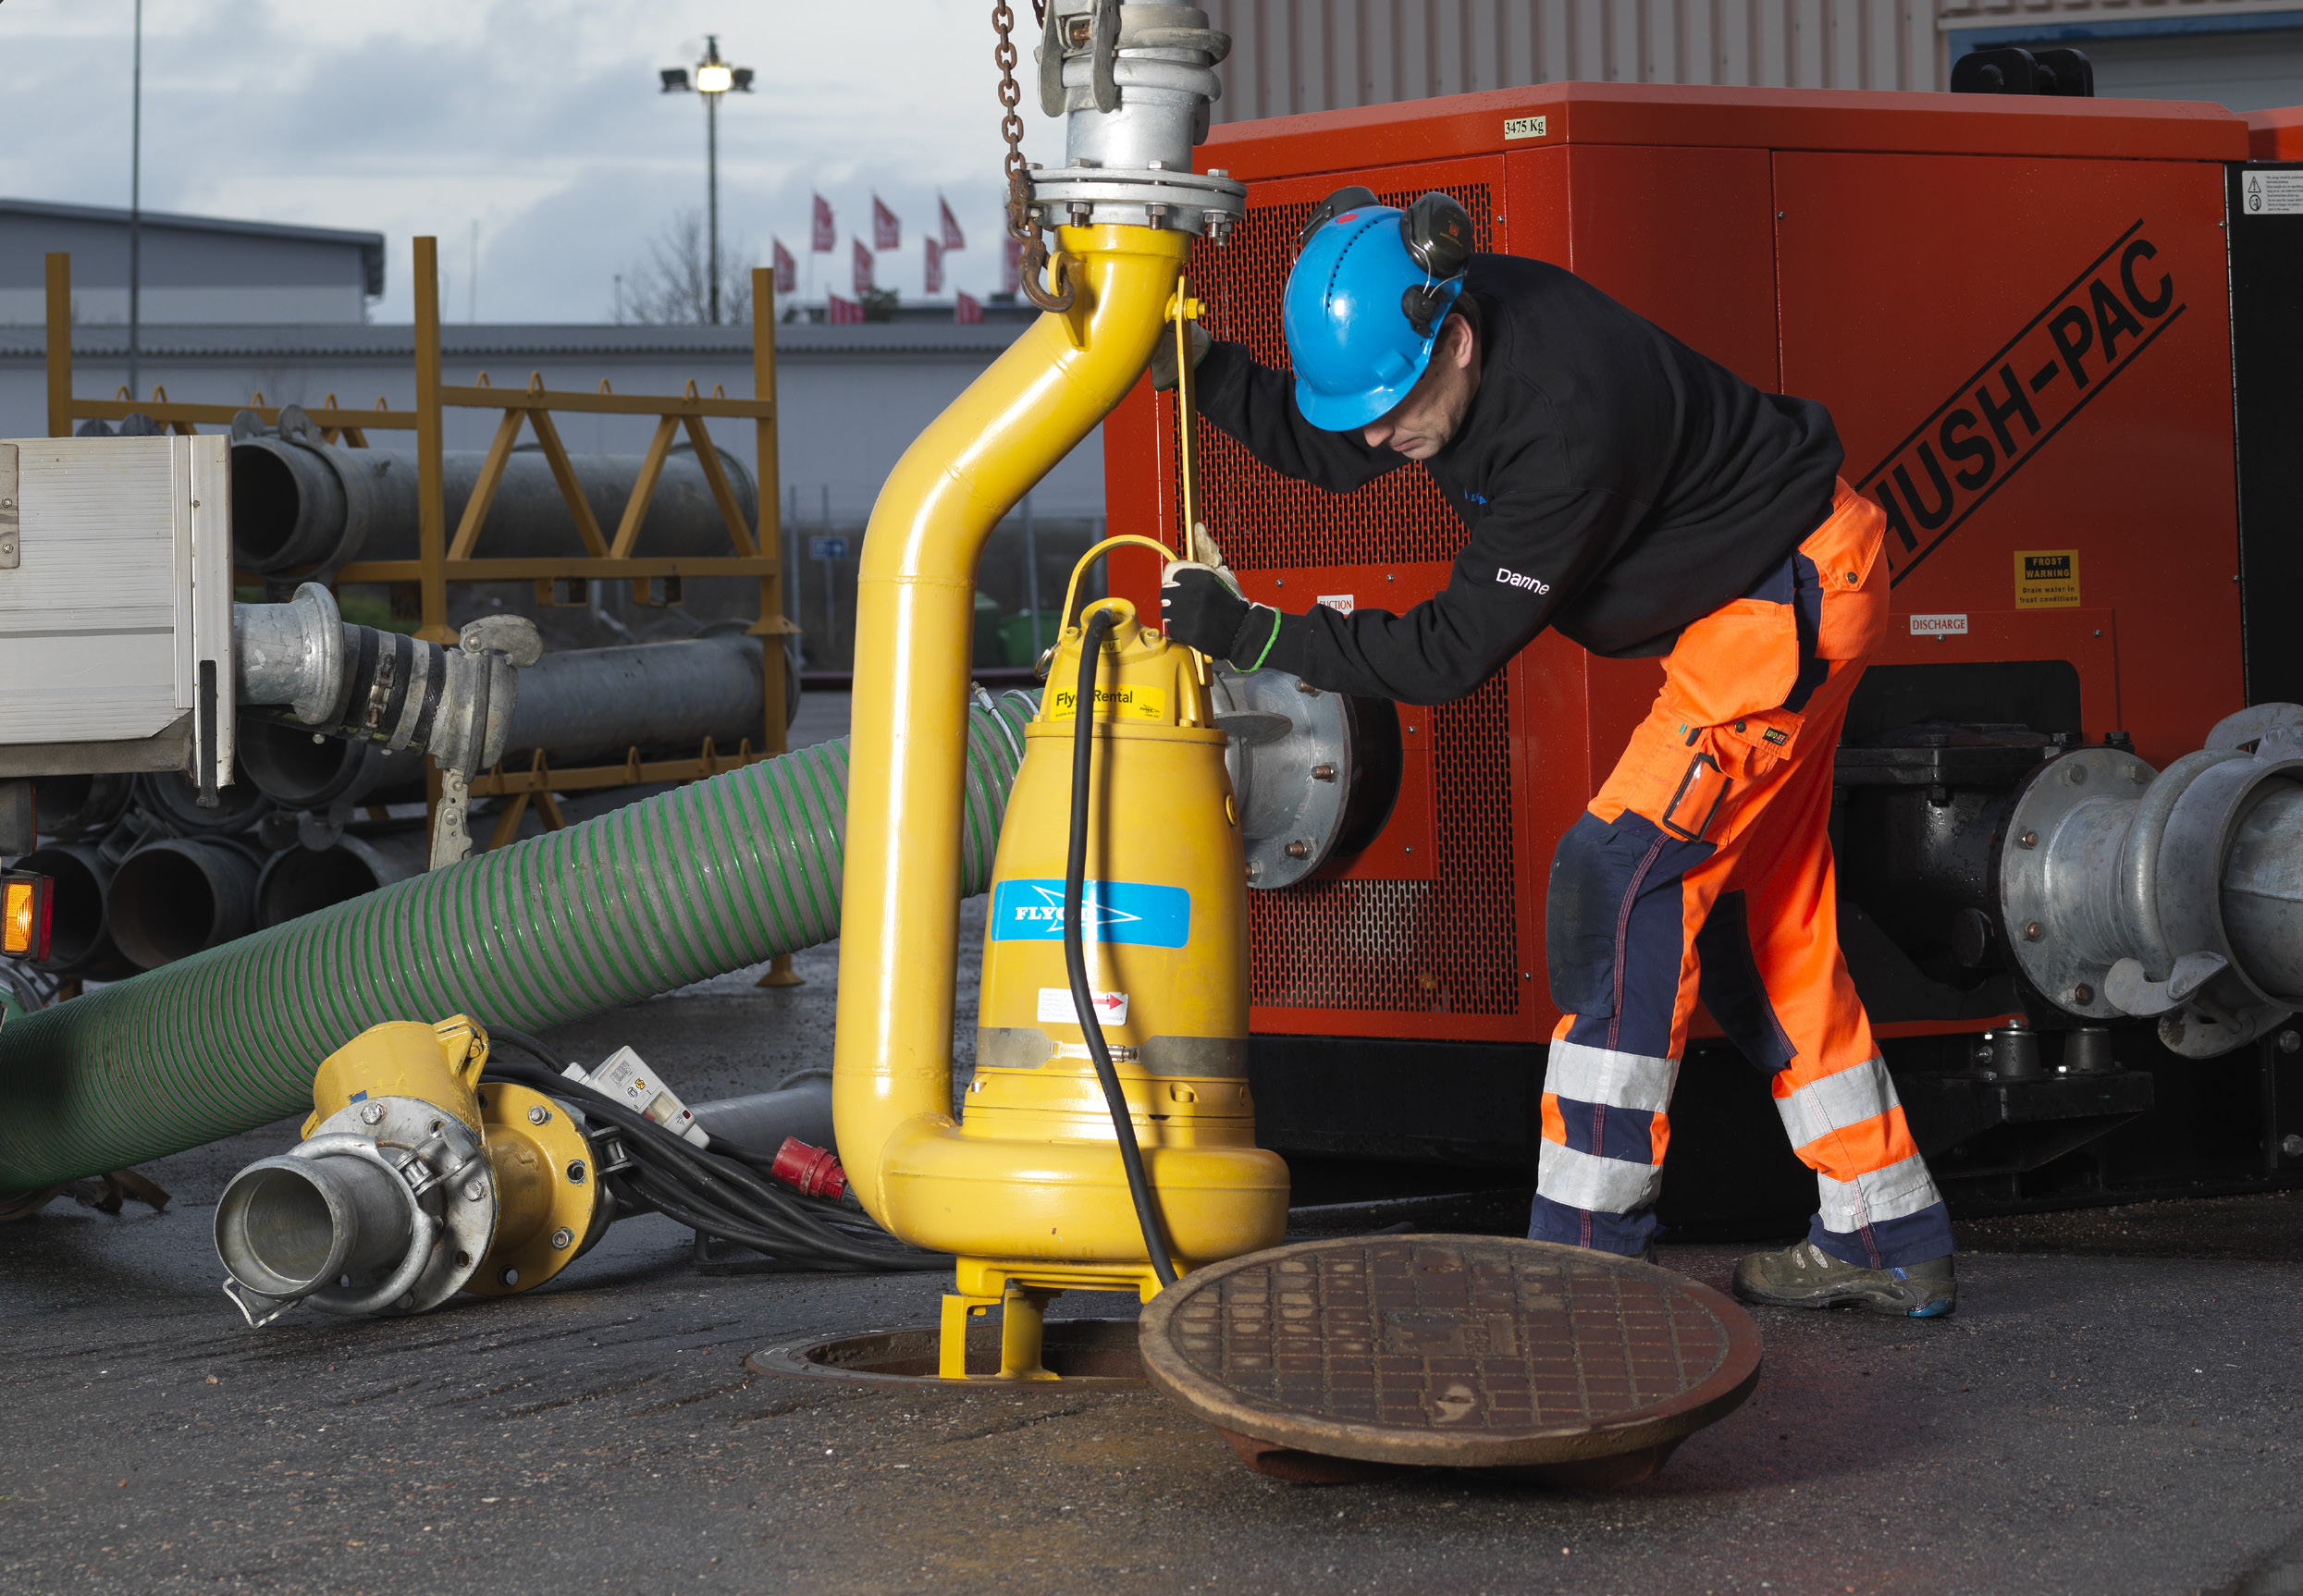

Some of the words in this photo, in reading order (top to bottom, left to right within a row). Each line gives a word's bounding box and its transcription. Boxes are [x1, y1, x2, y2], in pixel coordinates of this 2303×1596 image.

[1505, 120, 1527, 135] 3475
[1530, 118, 1545, 135] Kg
[1874, 239, 2174, 571] HUSH-PAC
[2033, 557, 2063, 566] FROST
[2026, 569, 2070, 579] WARNING
[1496, 567, 1550, 595] Danne
[2039, 595, 2078, 603] conditions
[1912, 619, 1965, 630] DISCHARGE
[1093, 689, 1133, 704] Rental
